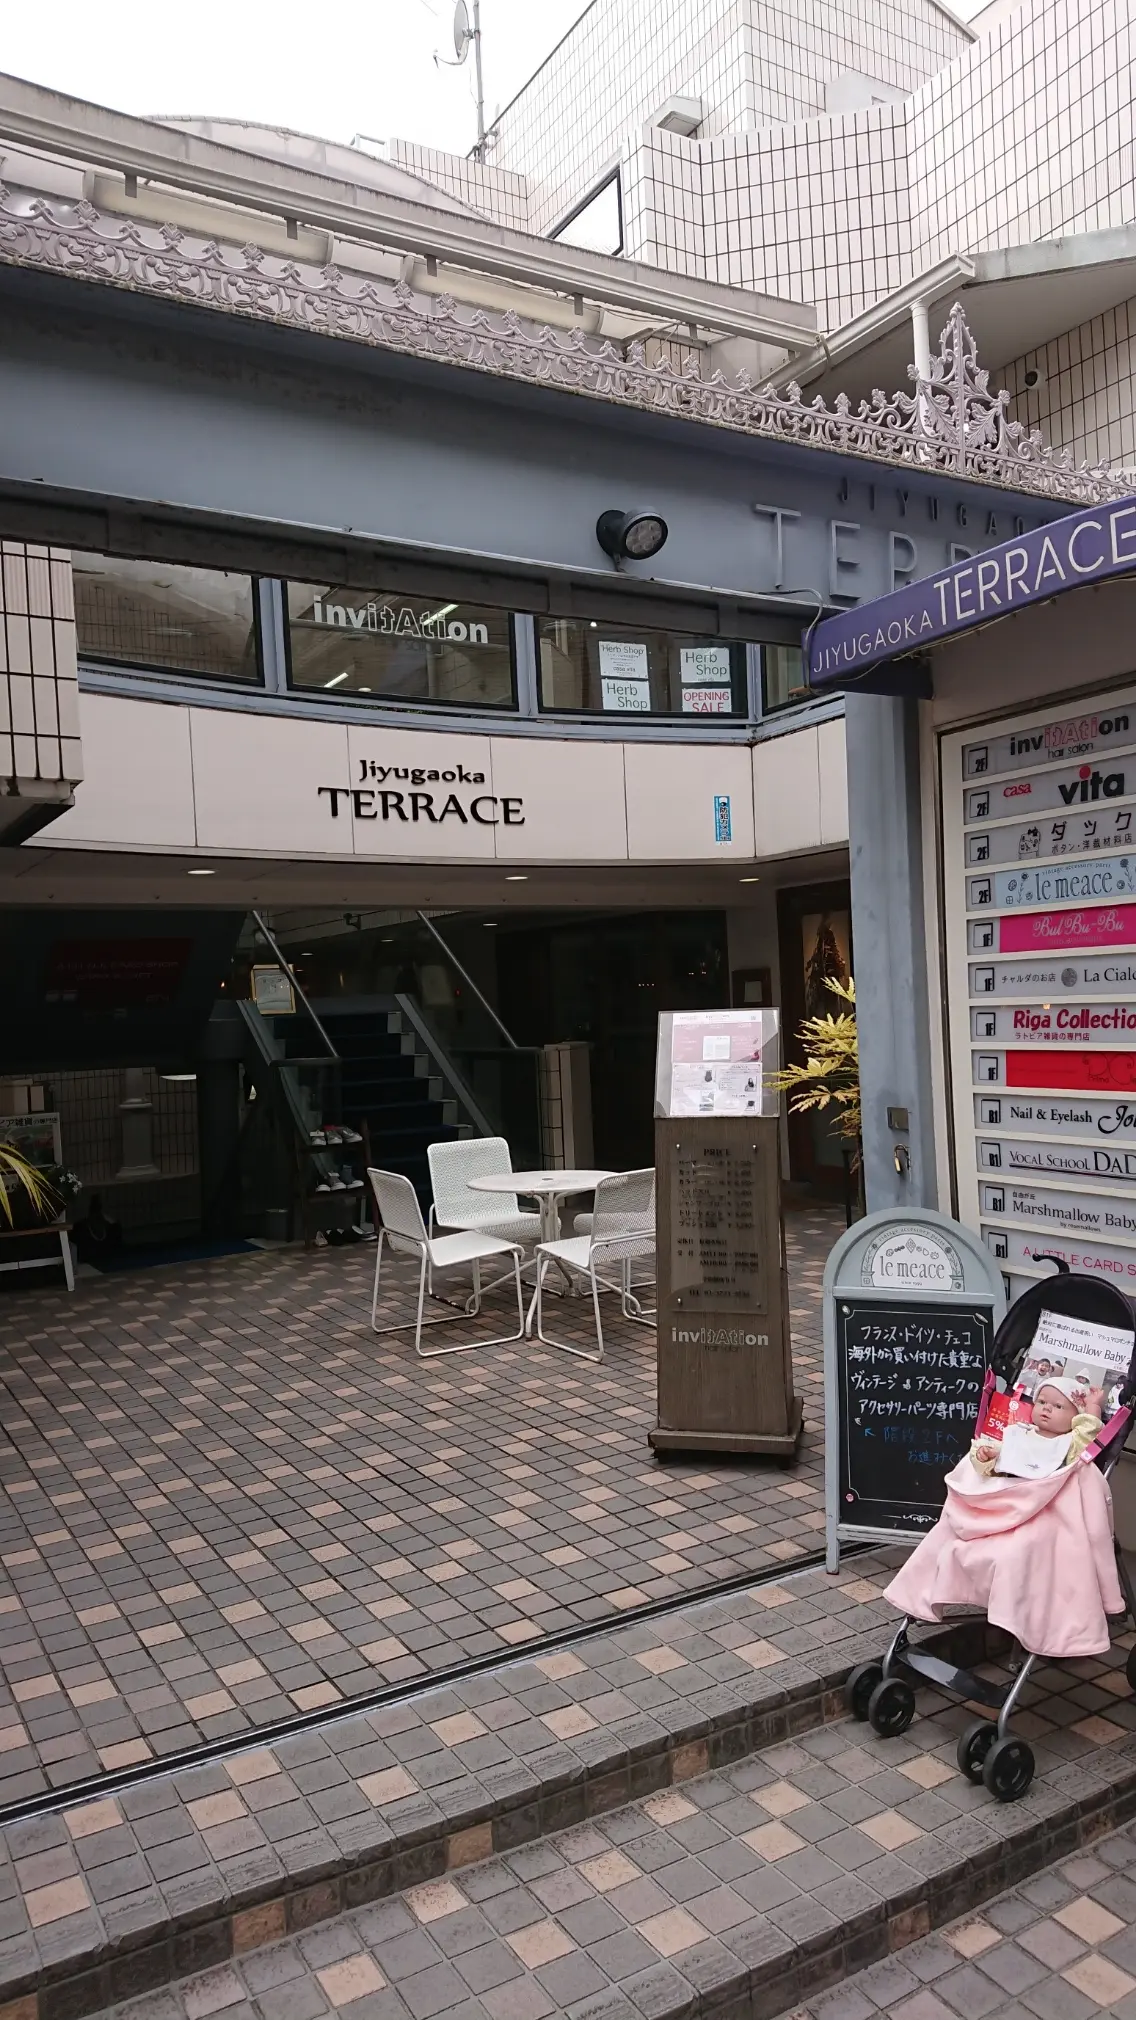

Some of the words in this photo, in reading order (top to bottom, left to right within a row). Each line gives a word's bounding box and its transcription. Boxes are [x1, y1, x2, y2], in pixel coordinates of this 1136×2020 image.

[813, 609, 934, 673] JIYUGAOKA
[933, 507, 1136, 626] TERRACE
[601, 644, 621, 653] Herb
[623, 646, 644, 657] Shop
[685, 652, 718, 664] Herb
[696, 664, 727, 678] Shop
[606, 682, 638, 696] Herb
[683, 691, 730, 701] OPENING
[617, 696, 648, 710] Shop
[1067, 742, 1094, 754] salon
[359, 760, 486, 785] Jiyugaoka
[975, 758, 987, 772] 2F
[976, 803, 988, 817] 2F
[1003, 782, 1032, 798] casa
[1058, 765, 1125, 805] vita
[318, 787, 526, 825] TERRACE
[977, 847, 988, 861] 2F
[978, 890, 990, 904] 2F
[1035, 873, 1051, 900] le
[1055, 871, 1113, 899] meace
[982, 934, 992, 947] 1F
[984, 978, 994, 991] 1F
[1084, 969, 1100, 982] La
[985, 1022, 994, 1036] 1F
[1013, 1009, 1051, 1031] Riga
[987, 1067, 996, 1080] 1F
[988, 1110, 998, 1123] B1
[1010, 1106, 1033, 1119] Nail
[1036, 1109, 1047, 1120] &
[1051, 1109, 1093, 1124] Eyelash
[989, 1153, 999, 1166] B1
[992, 1197, 1002, 1211] B1
[1013, 1200, 1100, 1224] Marshmallow
[880, 1256, 894, 1276] le
[896, 1261, 945, 1279] meace
[995, 1244, 1006, 1258] B1
[1023, 1246, 1031, 1257] A
[1082, 1256, 1123, 1273] CARD
[848, 1345, 983, 1368] 海外から買い付けた貴重な
[1038, 1332, 1103, 1358] Marshmallow
[1103, 1349, 1127, 1365] Baby
[858, 1399, 979, 1420] アクセサリーパーツ専門店
